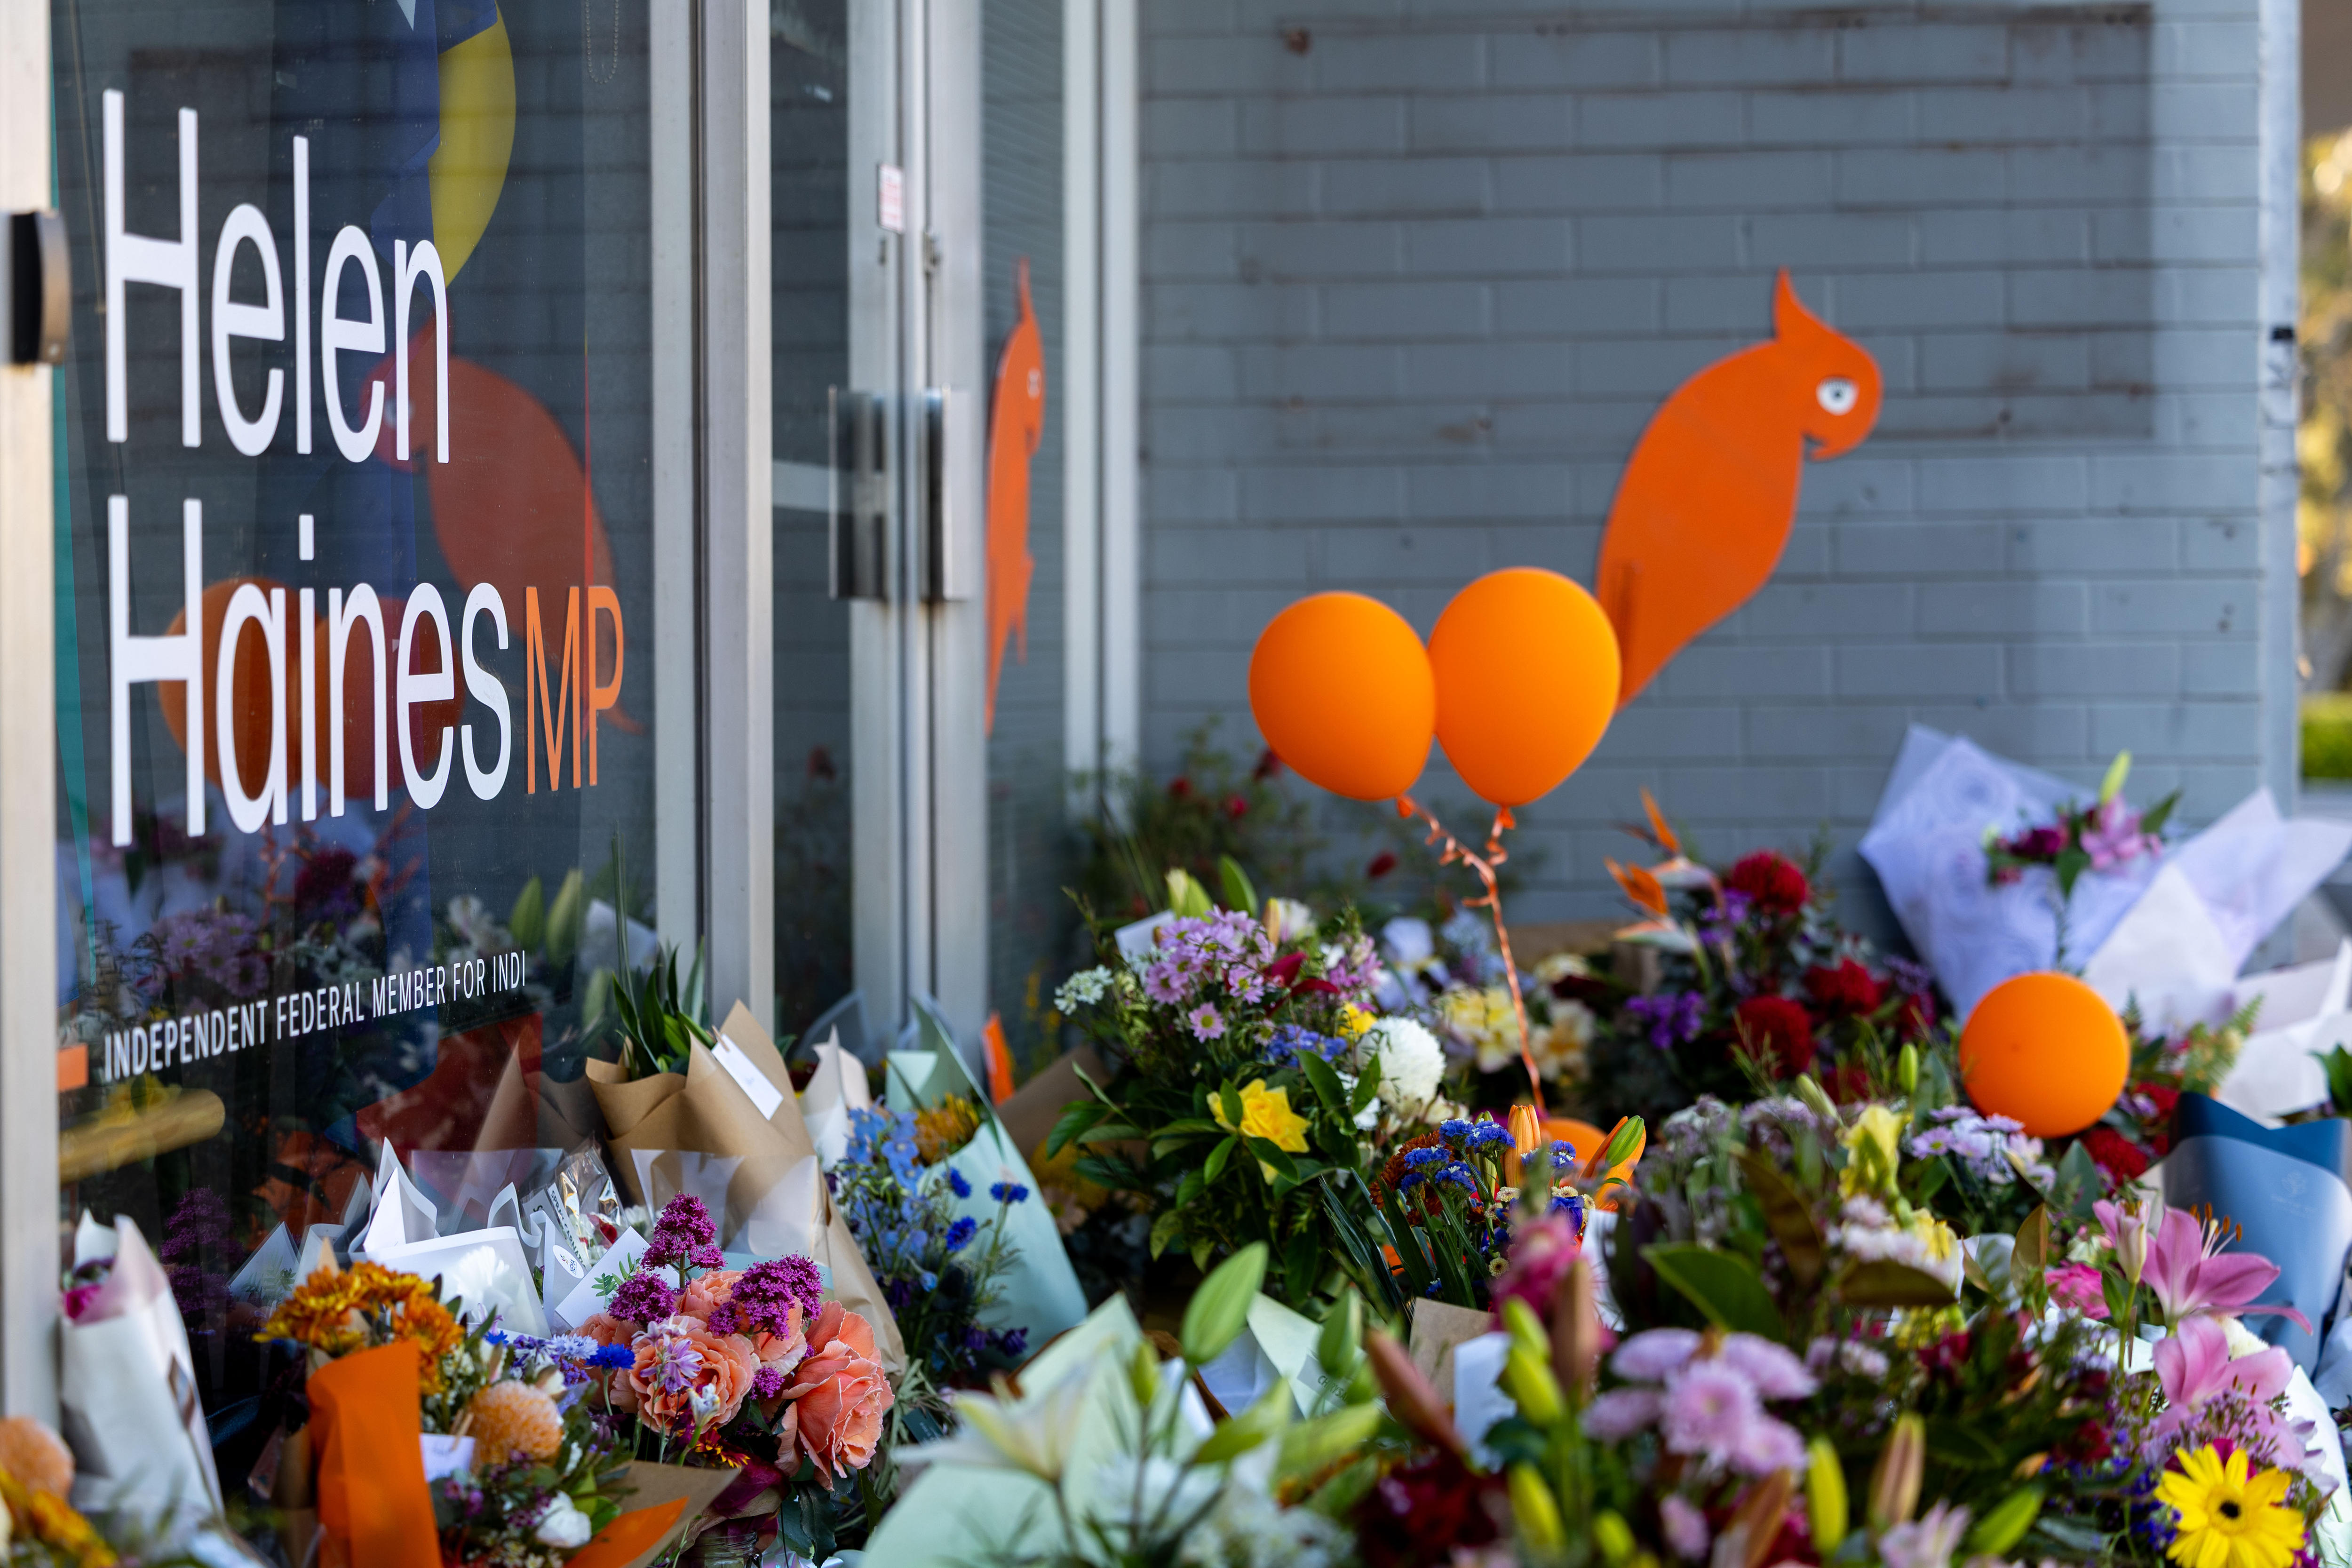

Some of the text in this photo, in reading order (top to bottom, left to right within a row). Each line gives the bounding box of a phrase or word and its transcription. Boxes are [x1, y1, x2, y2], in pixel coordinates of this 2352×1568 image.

[103, 88, 450, 463] Helen
[108, 494, 624, 847] Haines MP
[104, 950, 525, 1082] INDEPENDENT FEDERAL MEMBER FOR INDI
[564, 1223, 587, 1268] CARNAT
